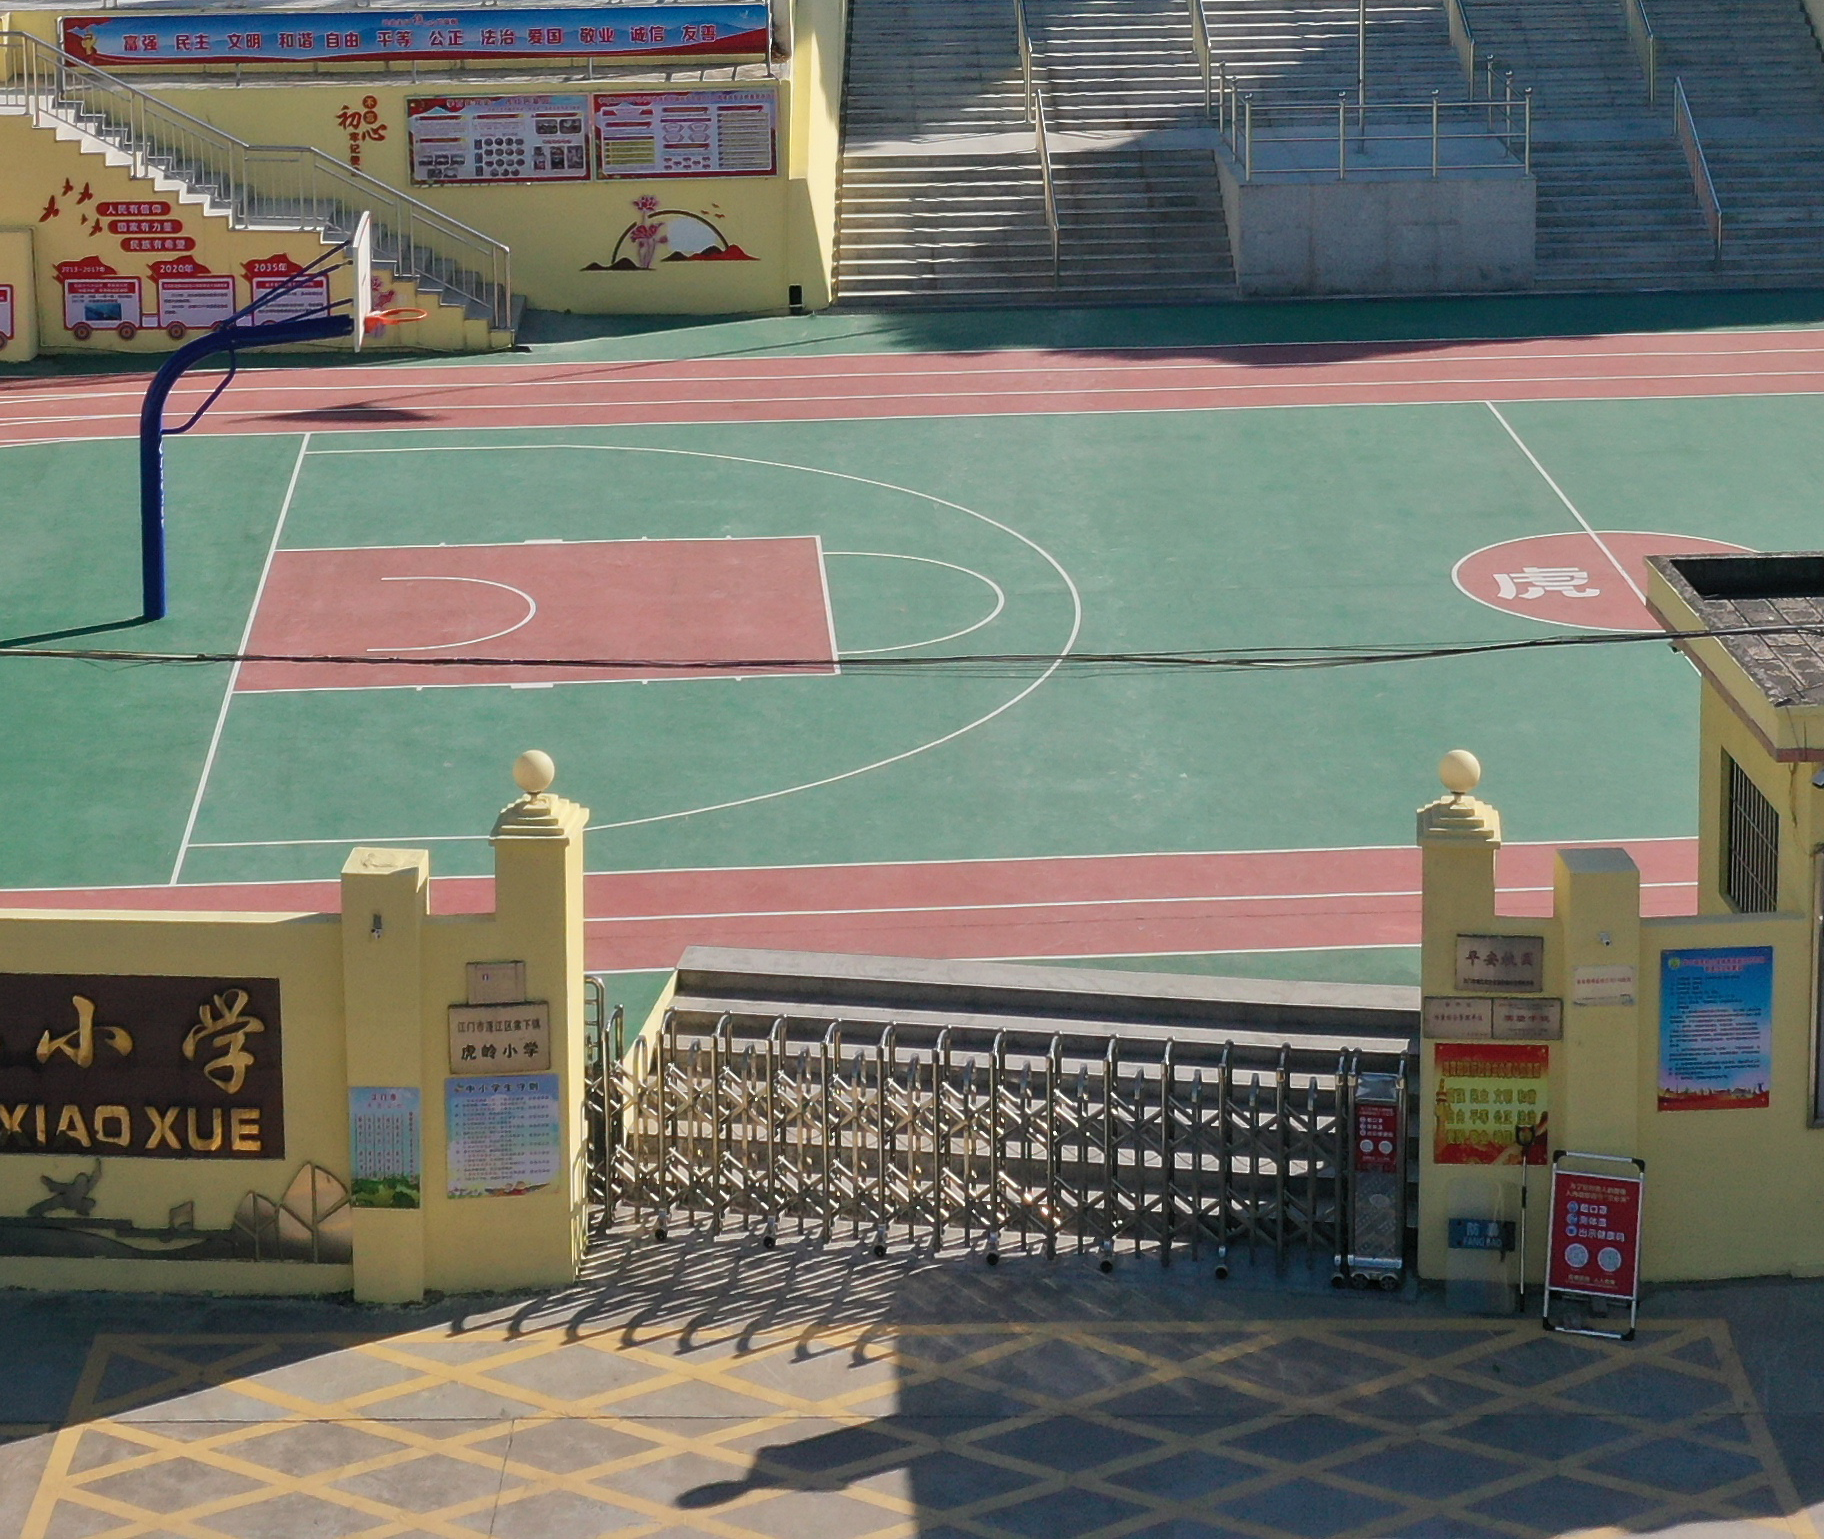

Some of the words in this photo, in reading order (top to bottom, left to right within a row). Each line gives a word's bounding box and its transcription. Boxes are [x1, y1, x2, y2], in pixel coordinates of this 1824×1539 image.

[123, 34, 158, 52] 富强
[175, 34, 211, 52] 民主
[228, 33, 262, 50] 文明
[279, 32, 314, 50] 和谐
[325, 32, 360, 49] 自由
[376, 30, 412, 47] 平等
[428, 29, 464, 46] 公正
[480, 28, 514, 46] 法治
[528, 27, 563, 45] 爱国
[580, 26, 615, 44] 敬业
[630, 25, 665, 43] 诚信
[681, 24, 717, 42] 友善
[336, 104, 387, 142] 初心
[106, 204, 161, 215] 人民有信仰
[117, 221, 173, 232] 国家有力量
[129, 239, 187, 250] 民族有希望
[159, 265, 194, 273] 2020年
[254, 263, 287, 272] 2035年
[461, 1041, 539, 1061] 虎岭小学
[146, 1105, 262, 1152] XUE
